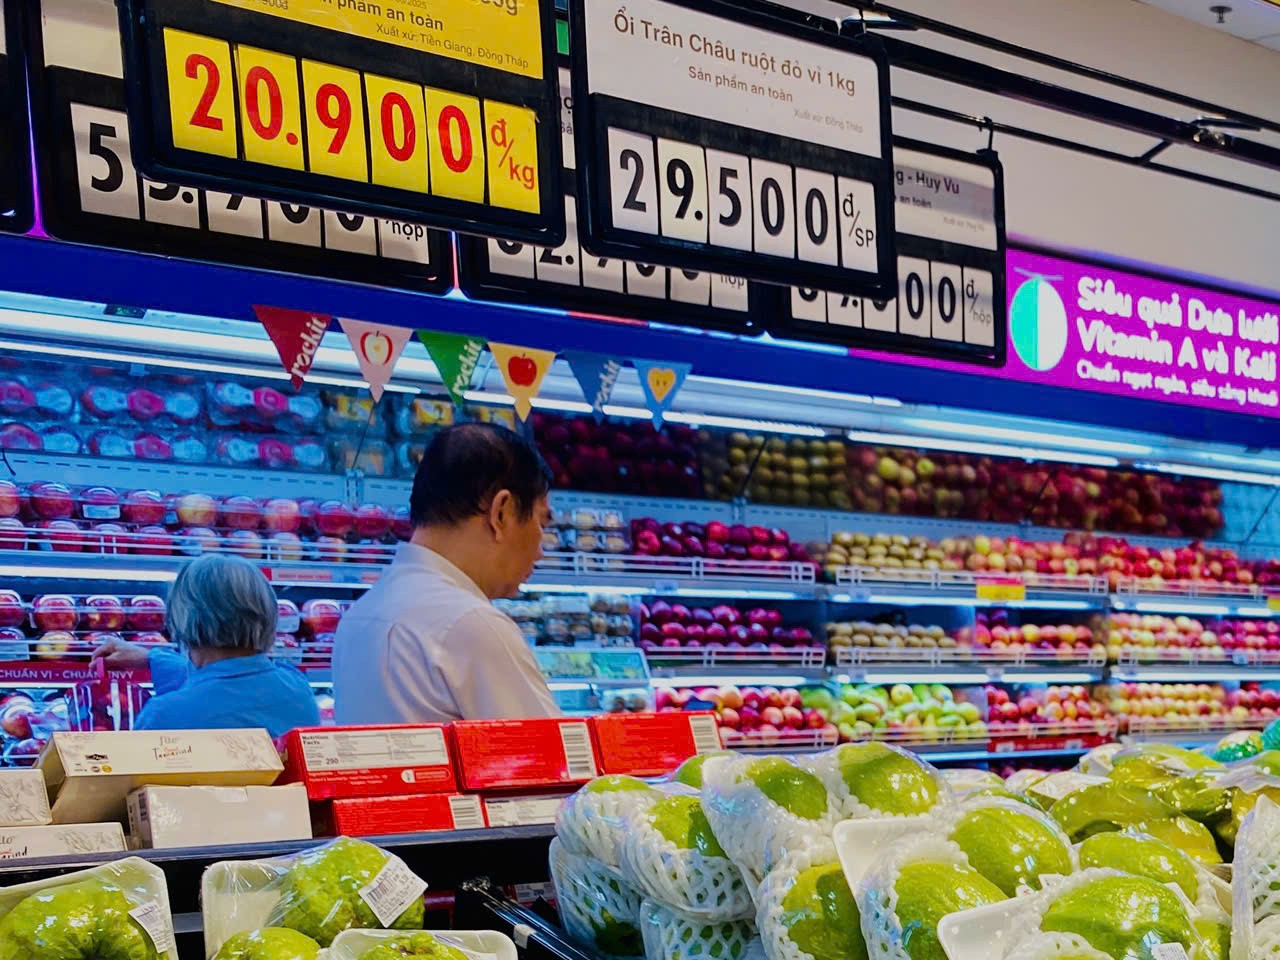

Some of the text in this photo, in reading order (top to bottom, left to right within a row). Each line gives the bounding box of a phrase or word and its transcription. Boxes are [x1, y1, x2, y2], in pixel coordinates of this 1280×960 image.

[376, 22, 399, 37] Xuất
[420, 33, 441, 48] Tiền
[505, 54, 529, 69] Tháp
[386, 8, 405, 22] an
[410, 10, 444, 31] toàn
[614, 6, 635, 35] Ổi
[641, 20, 683, 48] Trân
[689, 33, 735, 62] Châu
[741, 52, 776, 75] ruột
[781, 57, 802, 79] đỏ
[827, 71, 855, 97] 1kg
[688, 66, 793, 103] Sản phẩm an toàn
[185, 53, 473, 174] 20.900
[620, 149, 829, 245] 29.500
[916, 172, 941, 193] Huy
[1077, 276, 1132, 318] Siêu
[291, 316, 328, 379] rockit
[453, 340, 484, 397] rockit
[1077, 317, 1276, 382] Vitamin A và Kali
